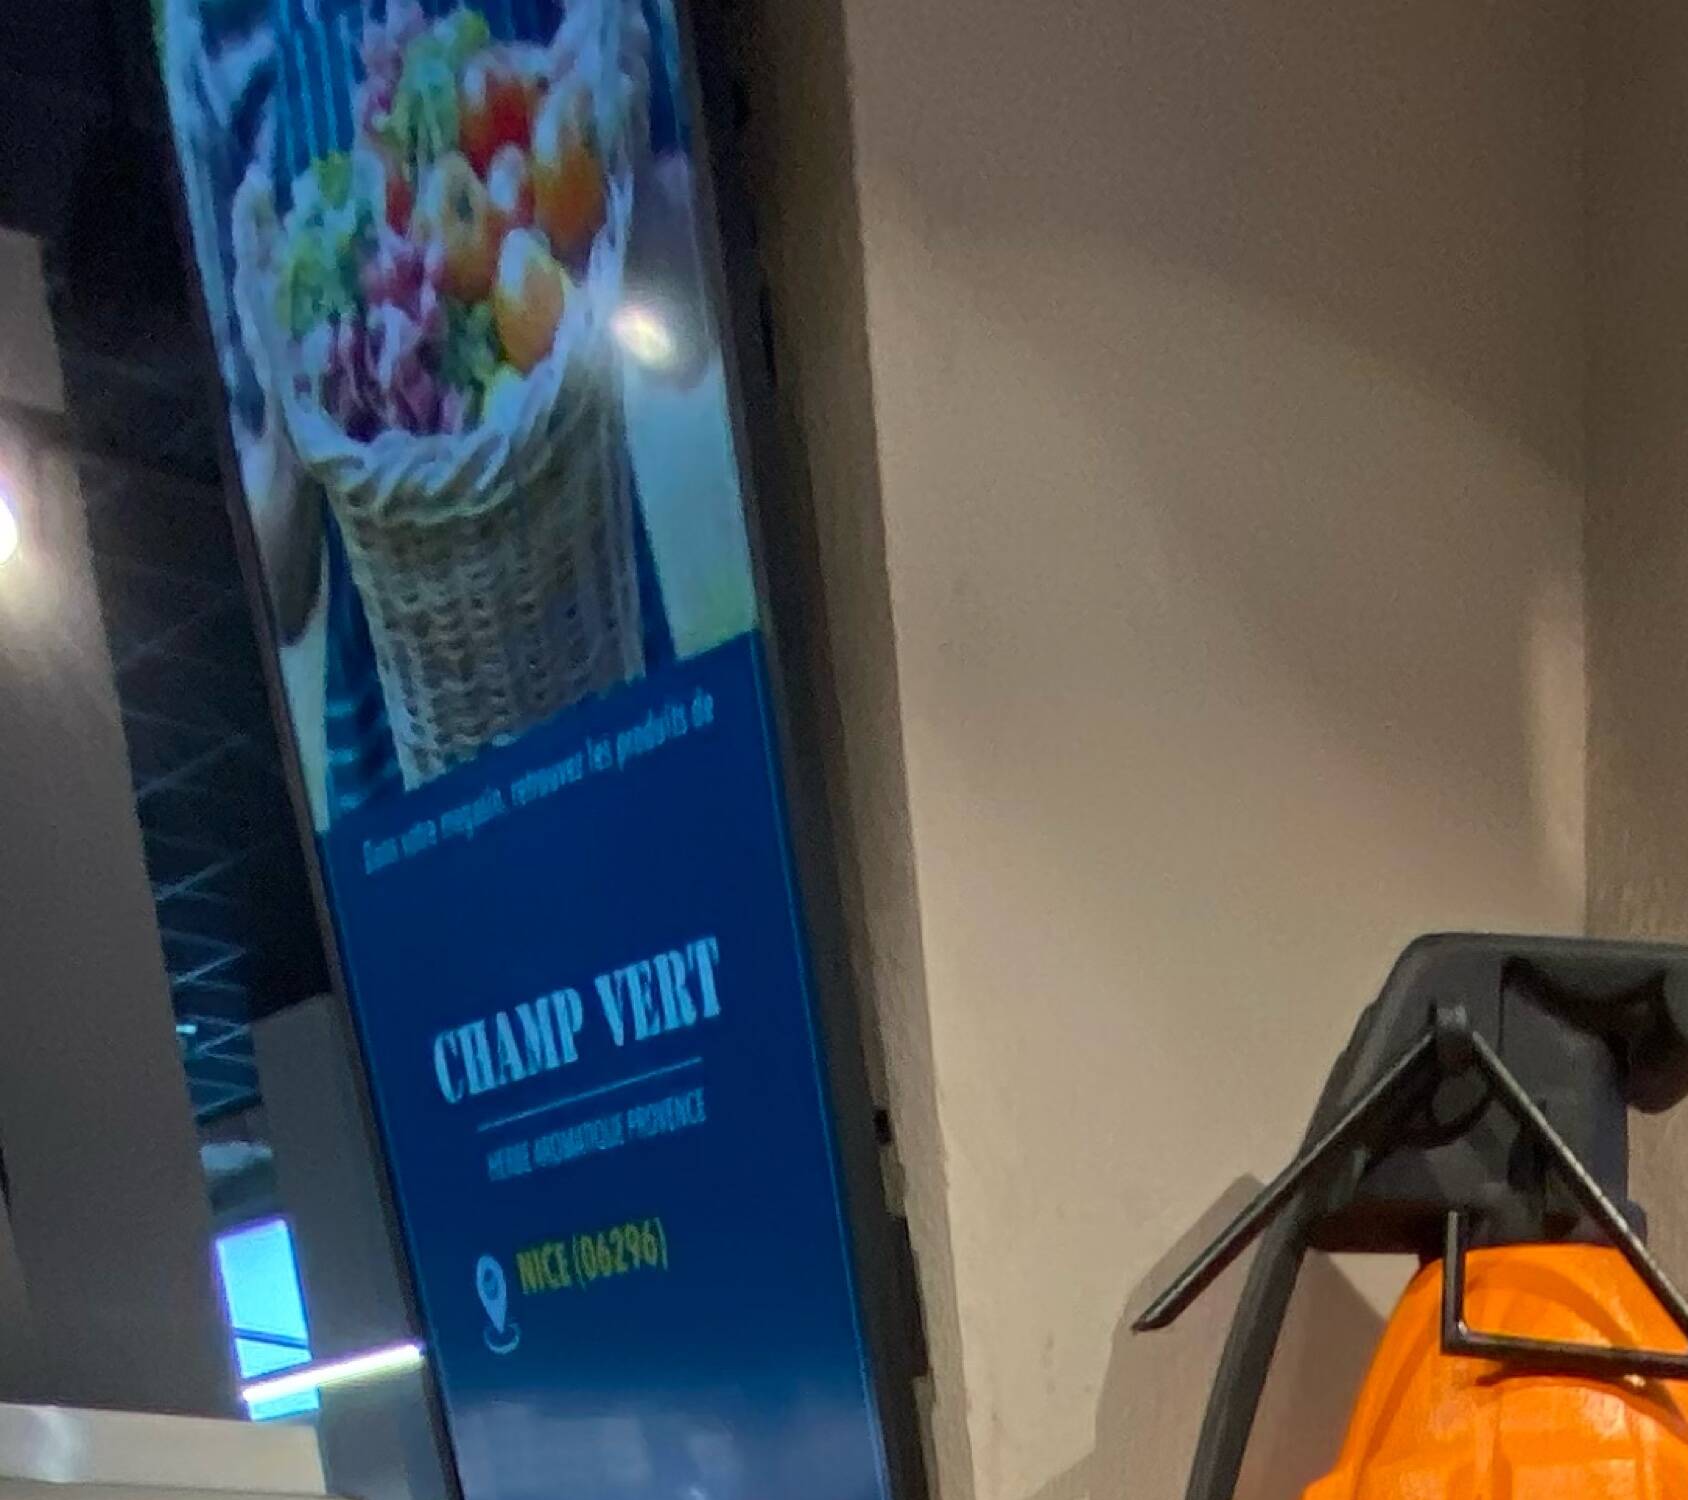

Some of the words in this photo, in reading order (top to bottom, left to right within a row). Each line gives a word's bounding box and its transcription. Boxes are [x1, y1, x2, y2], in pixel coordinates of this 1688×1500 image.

[434, 987, 583, 1104] CHAMP
[594, 935, 720, 1047] VERT
[516, 1241, 572, 1295] NICE
